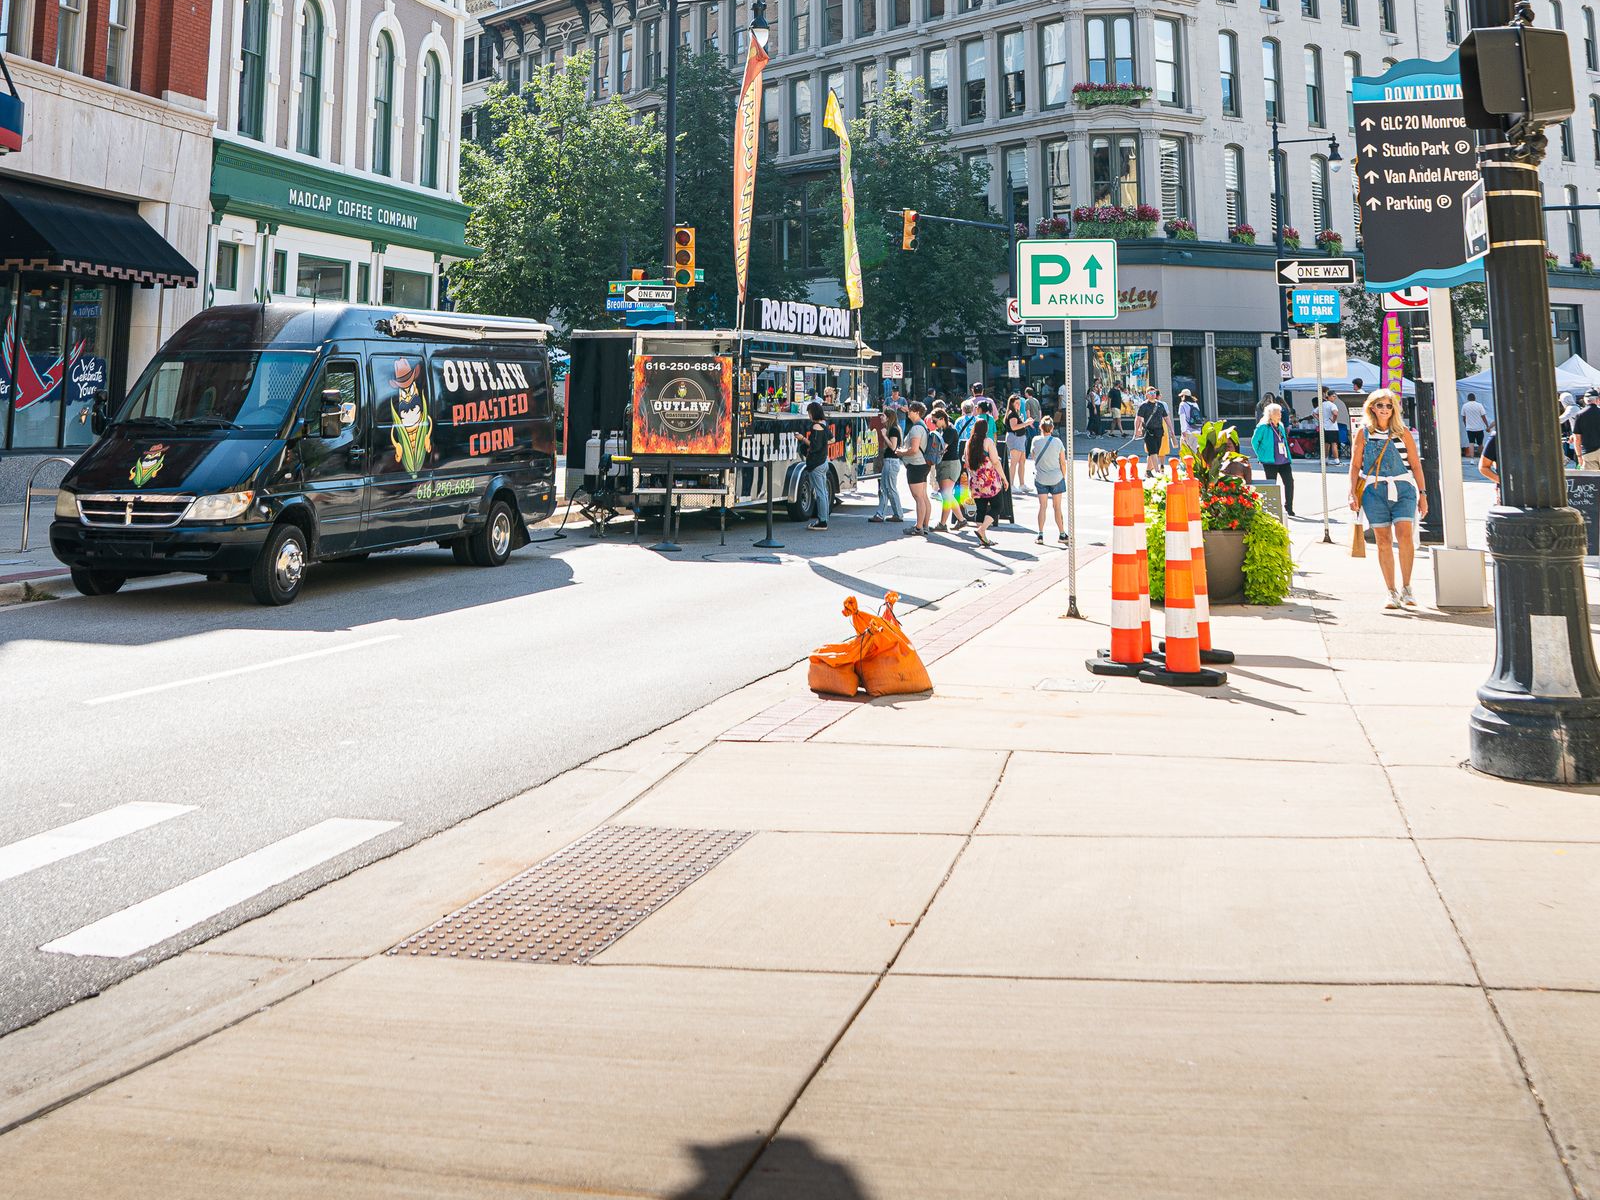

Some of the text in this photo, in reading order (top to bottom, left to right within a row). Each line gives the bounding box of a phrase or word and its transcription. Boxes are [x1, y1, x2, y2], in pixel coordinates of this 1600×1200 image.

[1380, 114, 1467, 131] GLC 20 Monroe
[1382, 142, 1420, 158] Studio
[1421, 141, 1450, 157] Park
[1383, 168, 1479, 184] Van Andel Arena
[289, 188, 418, 230] MADCAP COFFEE COMPANY
[1386, 195, 1432, 213] Parking
[1297, 267, 1345, 277] ONE WAY
[1296, 294, 1335, 304] PAY HERE
[761, 298, 850, 338] ROASTED CORN
[1299, 306, 1334, 316] TO PARK
[81, 357, 95, 372] We
[646, 362, 722, 371] 616-250-6854
[72, 364, 103, 383] Celebrate
[443, 360, 530, 392] OUTLAW
[452, 393, 529, 426] ROASTED
[654, 400, 712, 412] OUTLAW
[470, 426, 514, 456] CORN
[742, 432, 798, 462] OUTLAW
[416, 478, 476, 500] 616-250-6854
